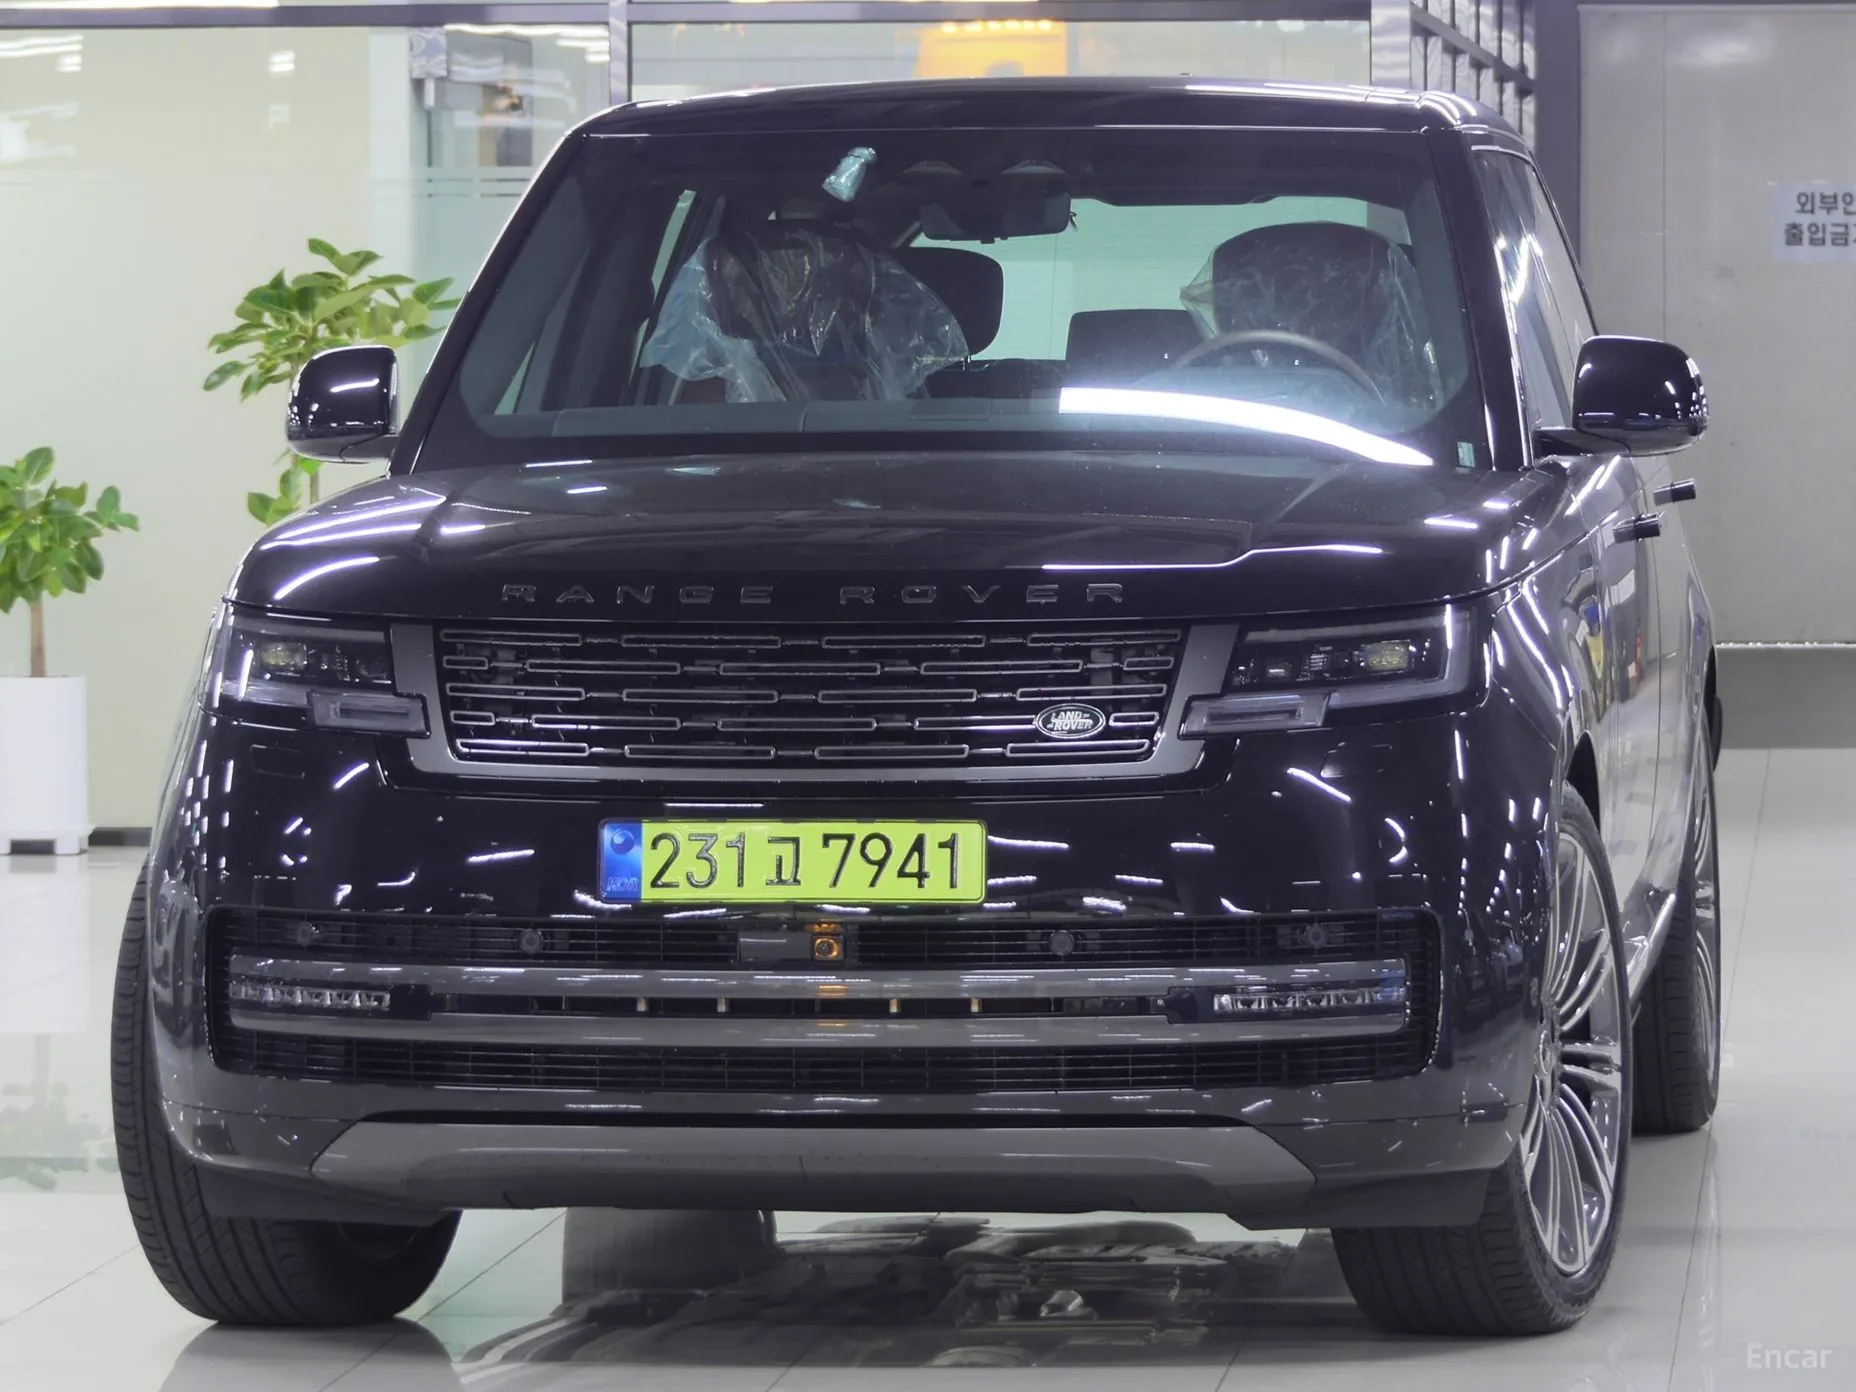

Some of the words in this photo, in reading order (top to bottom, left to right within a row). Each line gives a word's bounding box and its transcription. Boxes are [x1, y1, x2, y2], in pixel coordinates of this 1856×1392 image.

[502, 584, 774, 603] RANGE
[840, 584, 1122, 603] ROVER
[1051, 711, 1082, 722] LAND
[1053, 719, 1093, 730] ROVER
[821, 832, 960, 889] 7941
